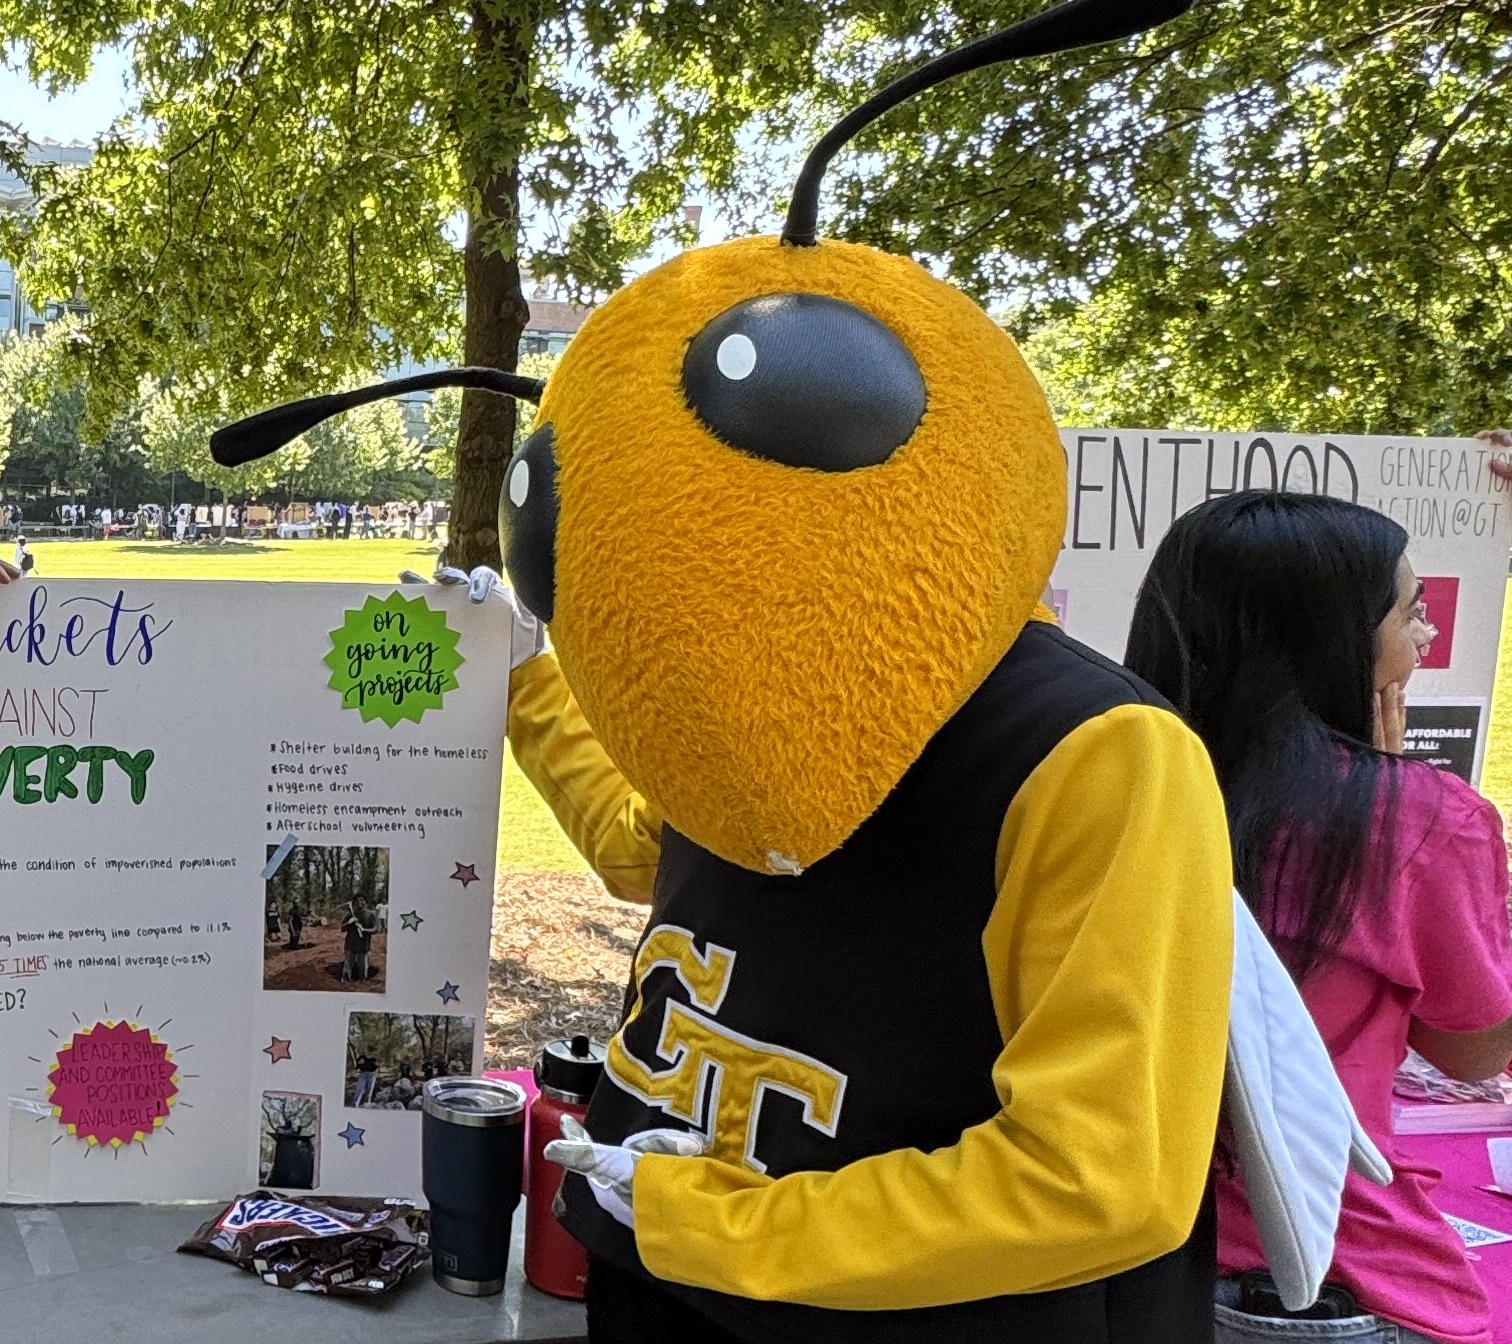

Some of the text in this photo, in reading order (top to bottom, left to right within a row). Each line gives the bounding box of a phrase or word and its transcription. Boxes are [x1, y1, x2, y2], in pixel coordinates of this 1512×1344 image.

[1060, 436, 1360, 551] ENTHOOD
[373, 610, 410, 637] on
[346, 638, 440, 679] going
[345, 669, 450, 706] projects
[280, 740, 488, 762] Shelter building for the homeless
[278, 763, 349, 776] Food drives
[276, 782, 364, 796] Hygeine drives
[274, 803, 463, 819] Homeless encampment outreach
[276, 820, 426, 840] Afterschool volunteering
[0, 857, 18, 870] the
[26, 857, 75, 871] condition
[83, 856, 97, 869] of
[105, 856, 172, 872] impoverished
[179, 857, 237, 872] populations
[17, 930, 45, 942] below
[48, 929, 64, 941] the
[69, 927, 106, 943] poverty
[111, 927, 131, 940] line
[137, 924, 183, 939] compared
[190, 923, 201, 933] to
[14, 954, 49, 974] TIMES
[53, 957, 72, 970] the
[78, 955, 121, 968] national
[72, 1042, 165, 1063] LEADERSHIP
[603, 923, 848, 1175] GT
[58, 1063, 167, 1086] AND COMMITTEE
[87, 1081, 167, 1104] POSITIONS
[78, 1100, 162, 1128] AVAILABLE!
